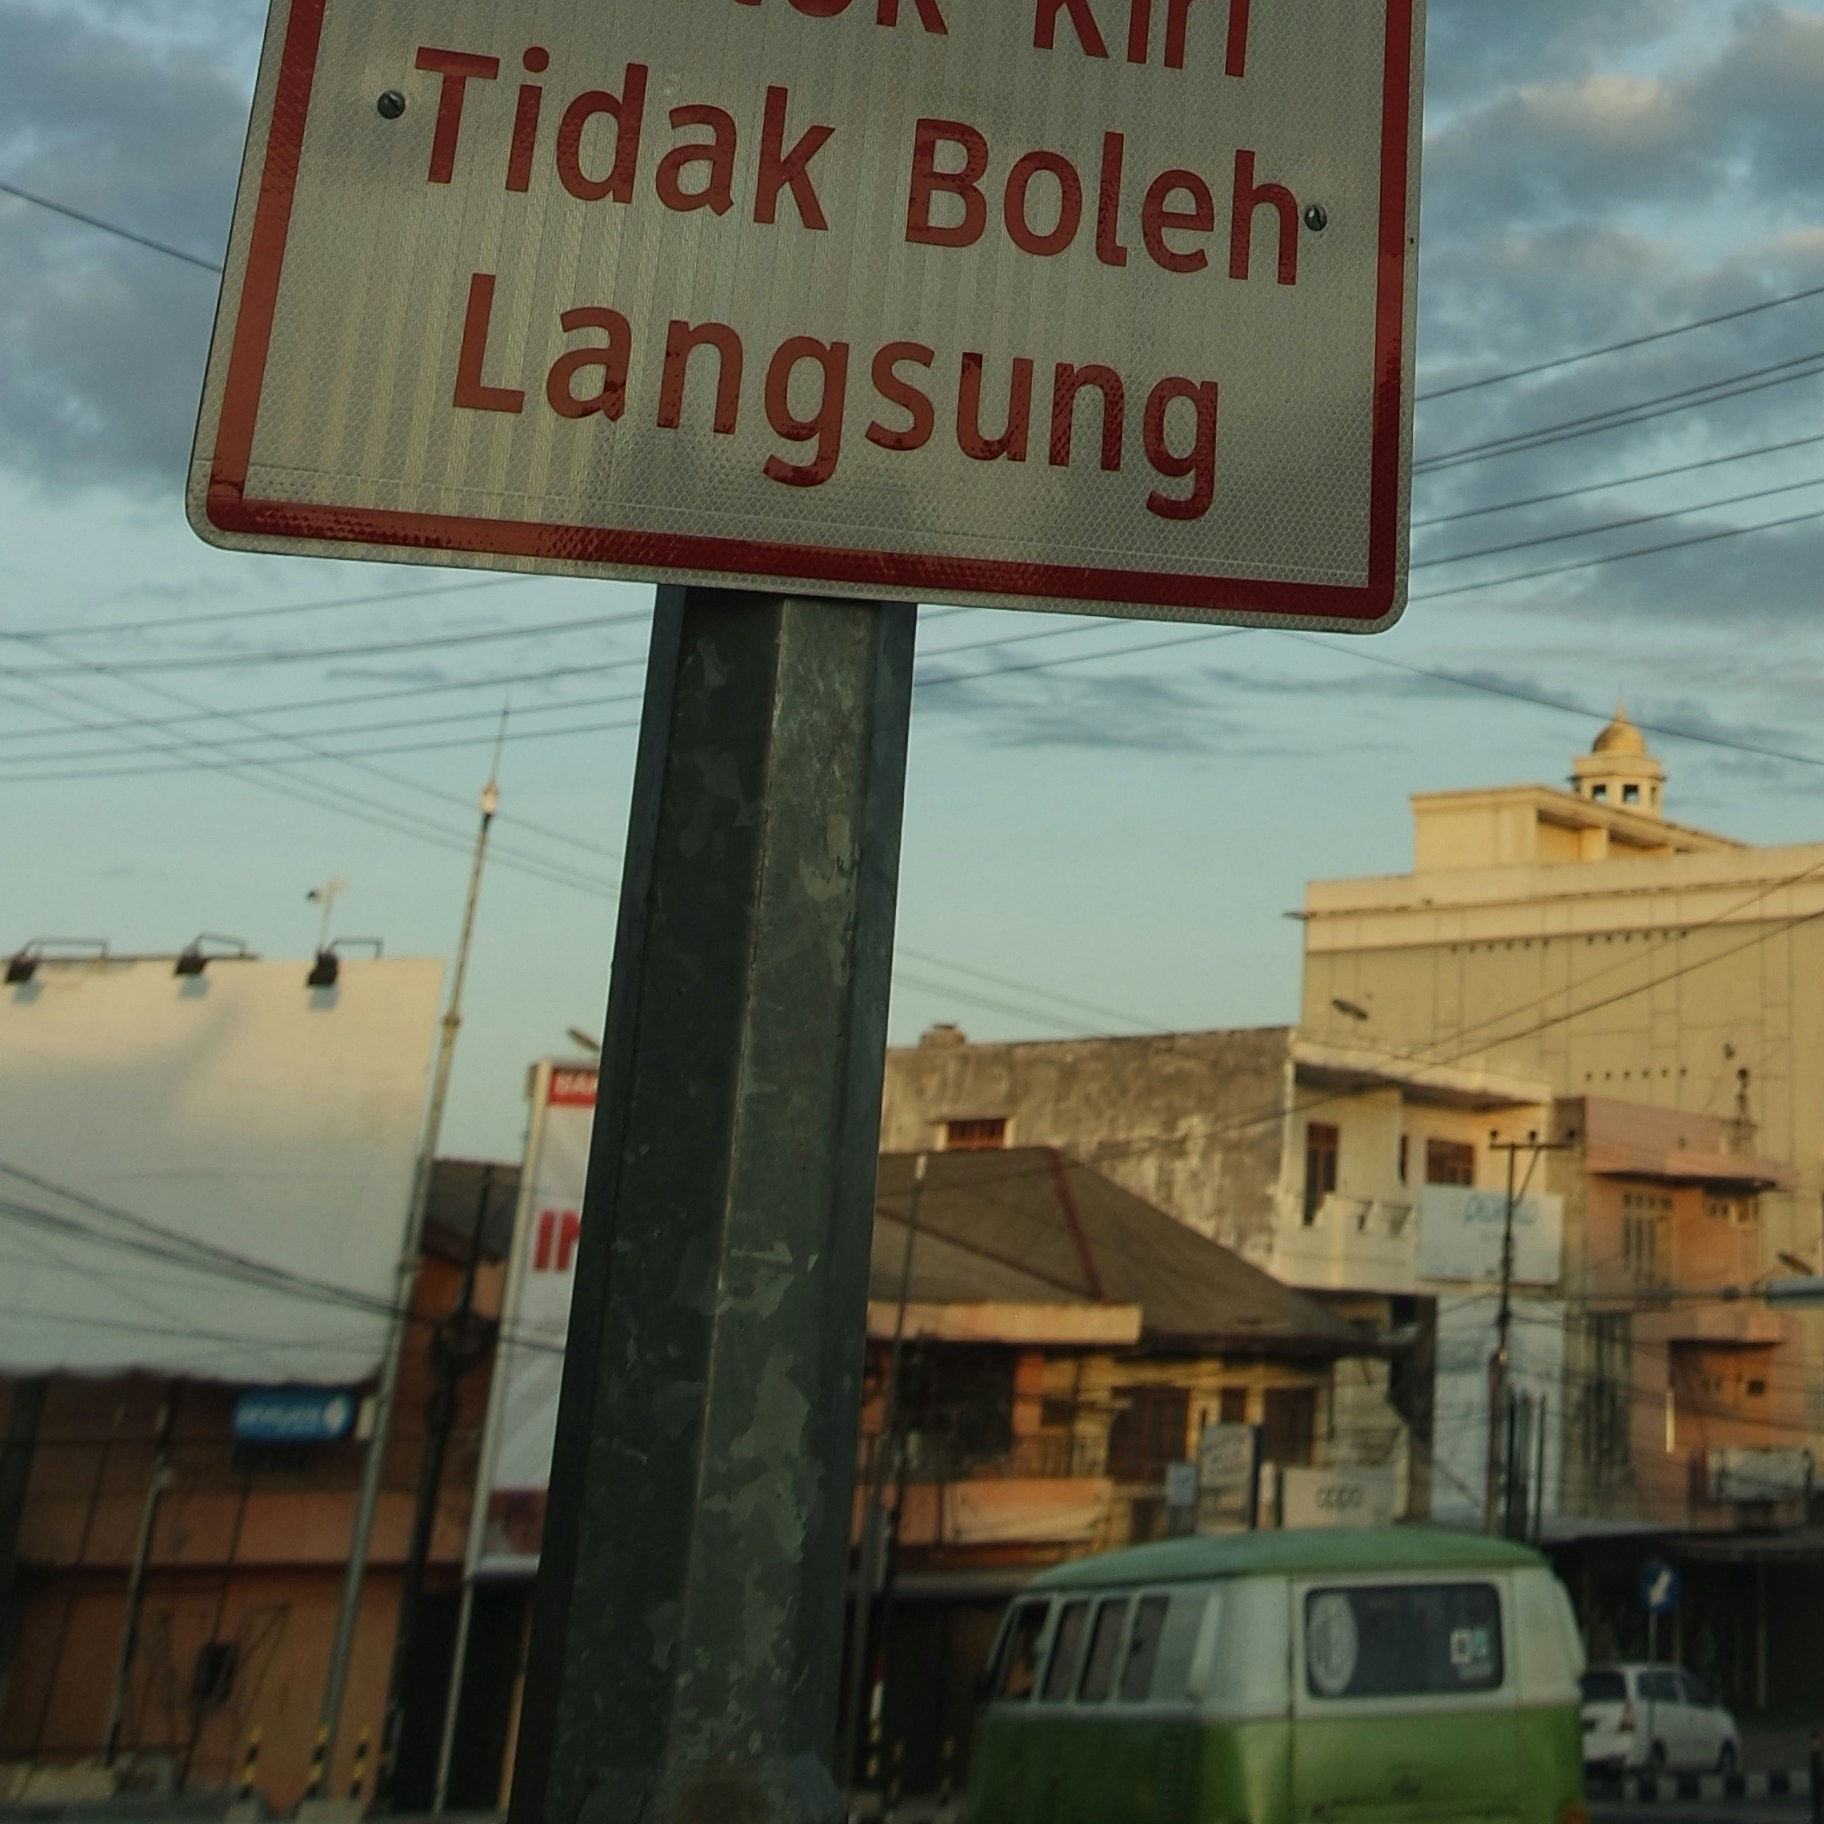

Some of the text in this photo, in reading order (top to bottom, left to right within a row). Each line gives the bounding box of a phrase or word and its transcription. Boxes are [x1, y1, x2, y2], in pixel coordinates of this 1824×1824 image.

[415, 46, 1300, 285] Tidak Boleh
[453, 273, 1219, 521] Langsung
